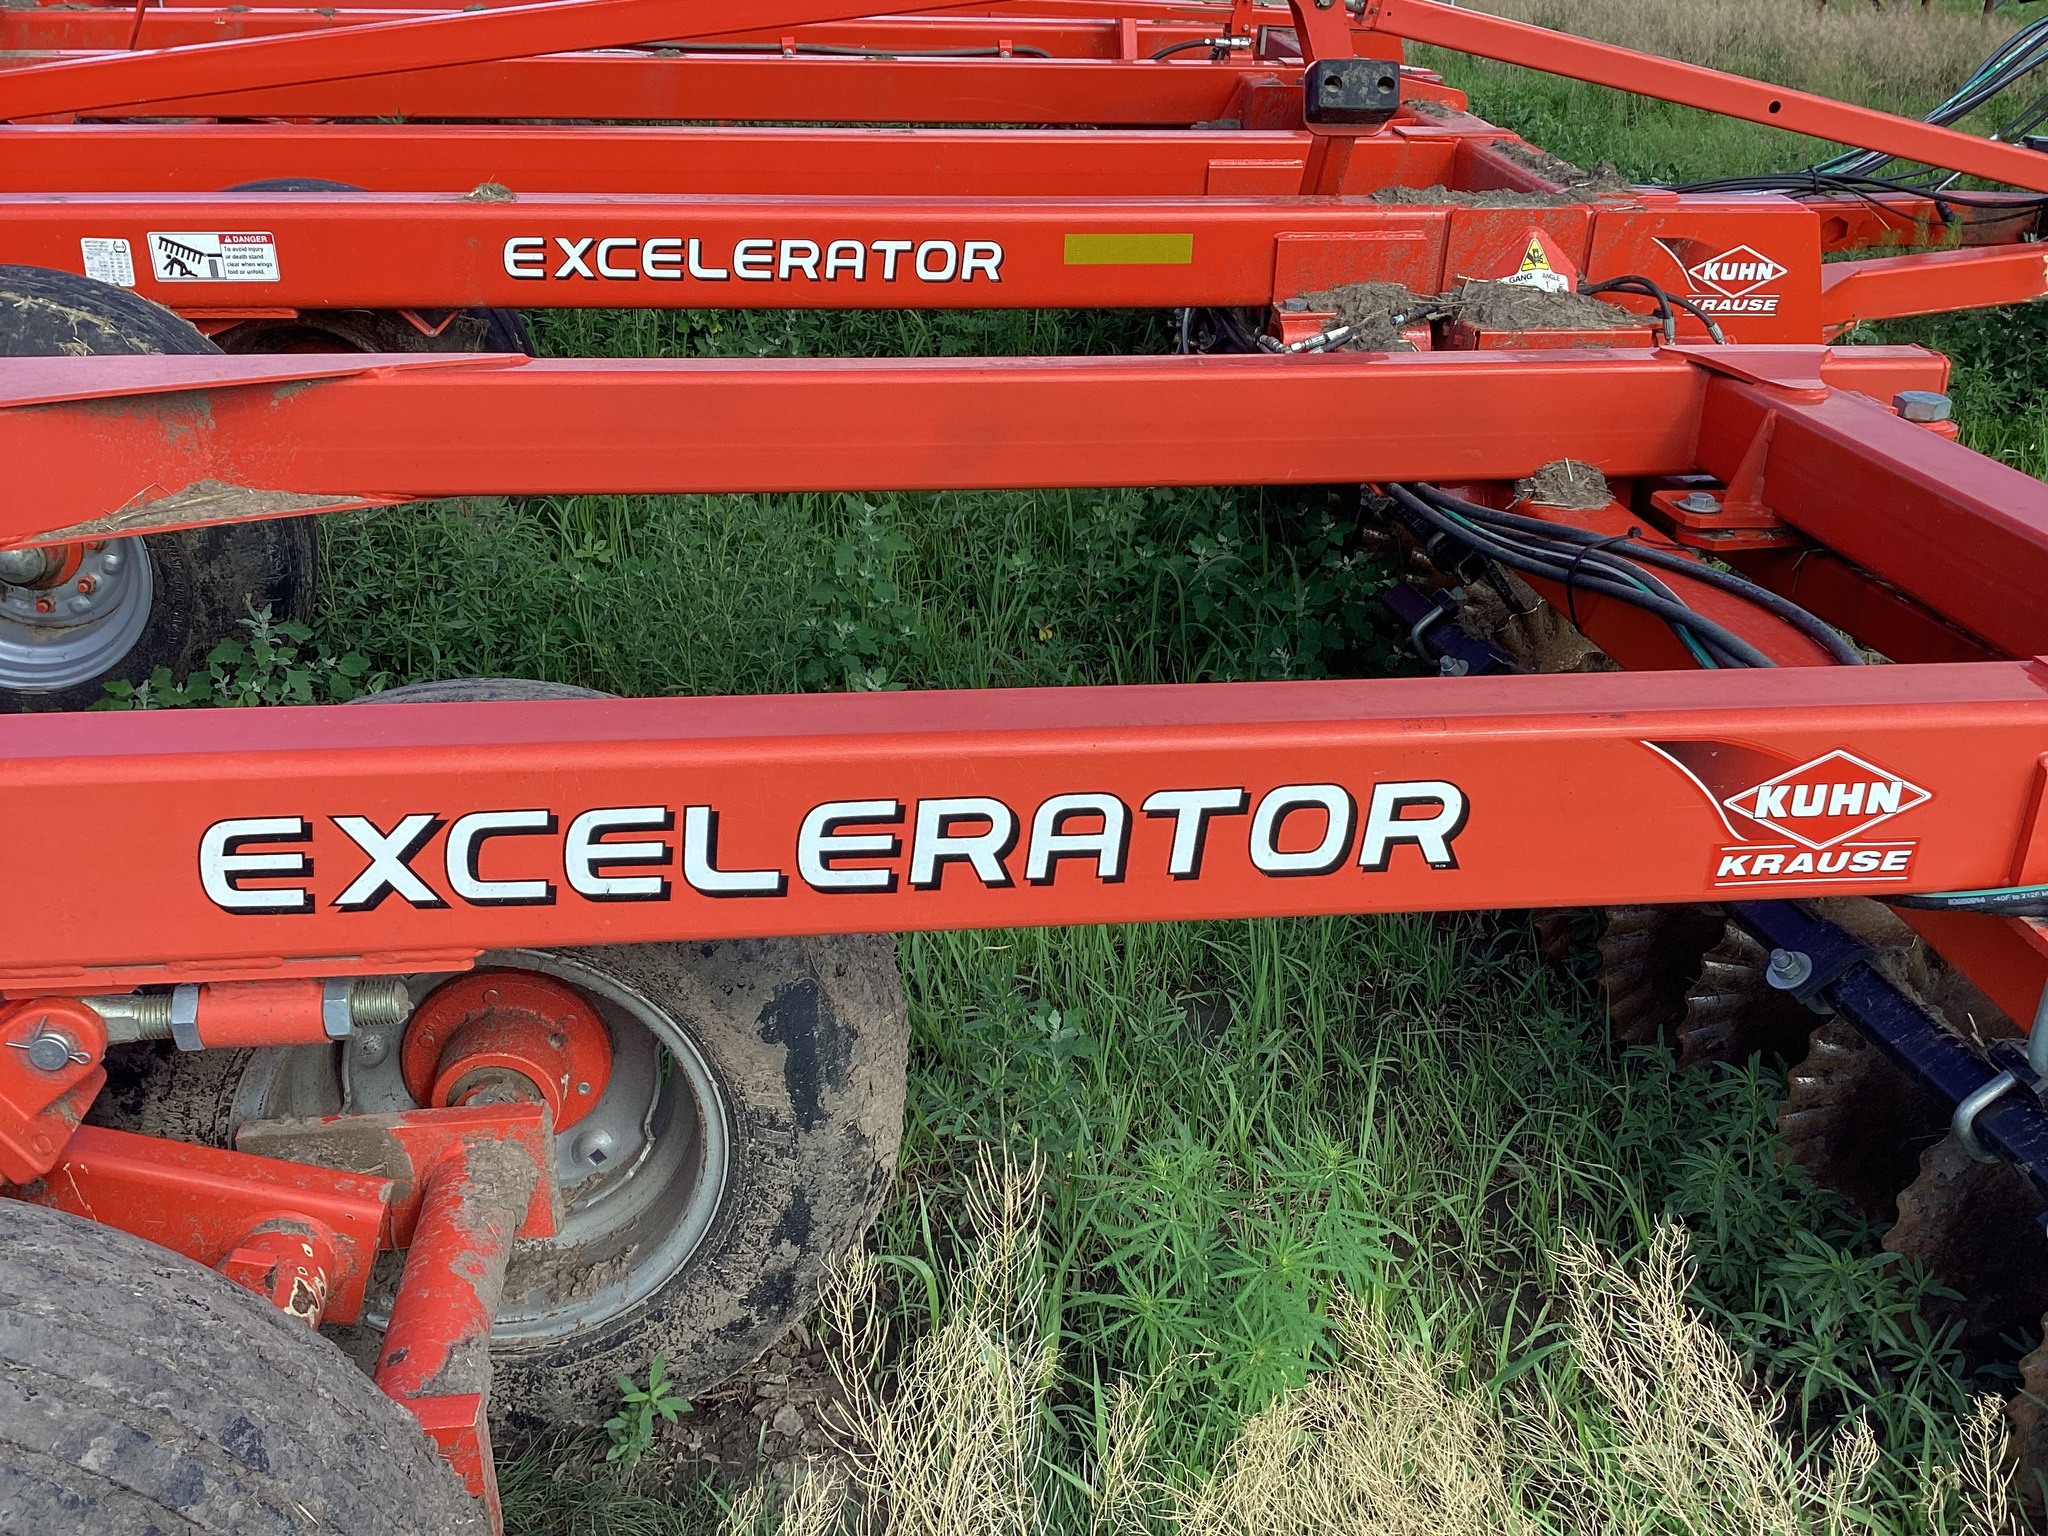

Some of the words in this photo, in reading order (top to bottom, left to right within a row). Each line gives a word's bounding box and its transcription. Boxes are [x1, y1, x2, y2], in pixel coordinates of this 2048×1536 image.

[232, 235, 267, 243] DANGER
[503, 236, 1005, 283] EXCELERATOR
[1703, 261, 1775, 281] KUHN
[1509, 272, 1533, 284] GANG
[1542, 272, 1560, 281] ANGLE
[1753, 780, 1904, 819] KUHN
[200, 779, 1470, 916] EXCELERATOR
[1716, 849, 1912, 877] KRAUSE
[2021, 891, 2040, 899] 212F
